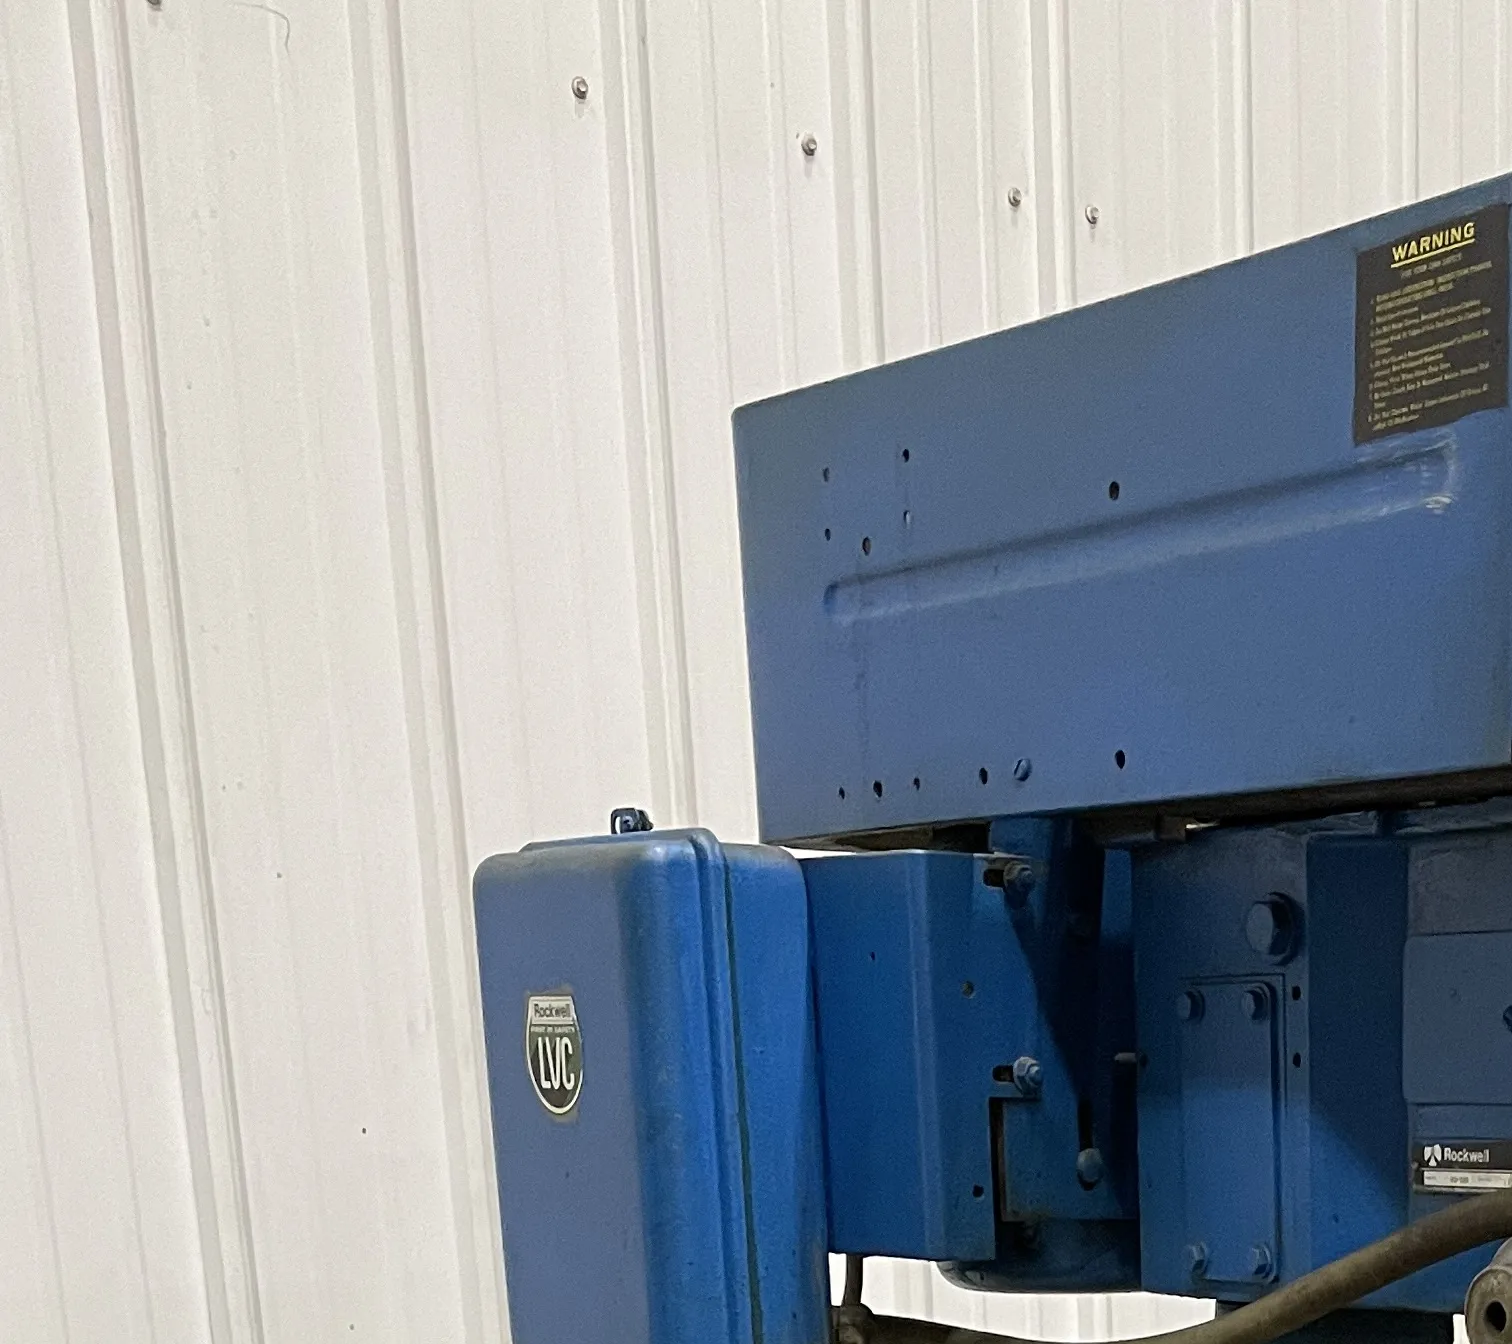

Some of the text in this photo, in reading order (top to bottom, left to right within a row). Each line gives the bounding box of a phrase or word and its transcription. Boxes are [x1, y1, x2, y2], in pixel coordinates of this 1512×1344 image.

[1391, 221, 1476, 263] WARNING
[533, 1003, 571, 1019] Rockwell
[537, 1036, 575, 1091] LVC
[1443, 1147, 1490, 1163] Rockwell
